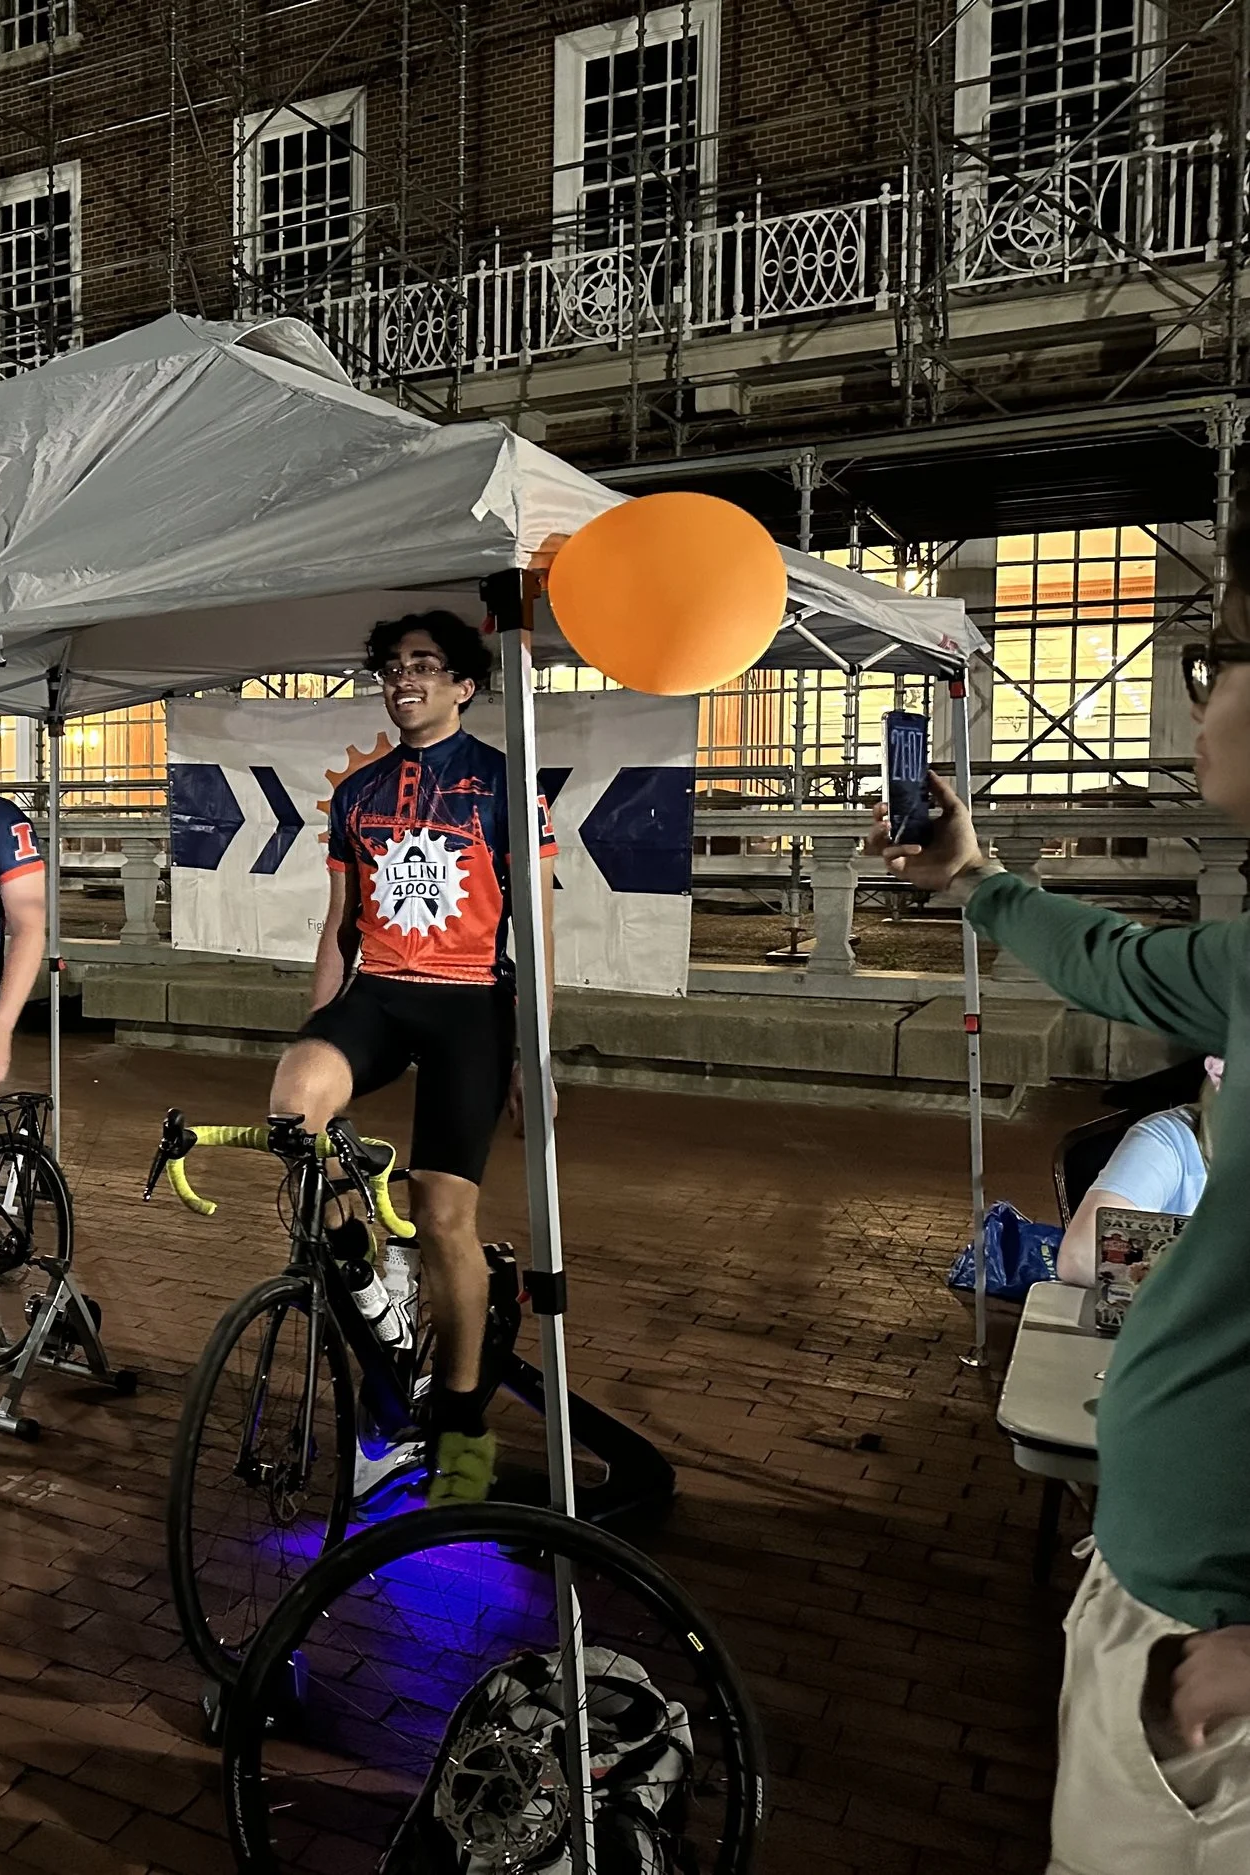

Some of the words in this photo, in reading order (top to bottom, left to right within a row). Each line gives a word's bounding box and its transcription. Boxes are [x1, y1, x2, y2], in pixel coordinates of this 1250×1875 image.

[891, 729, 924, 781] 21:07
[385, 864, 446, 881] ILLINI
[393, 883, 440, 897] 4000
[1103, 1219, 1134, 1229] SAY
[1138, 1222, 1170, 1232] GAY
